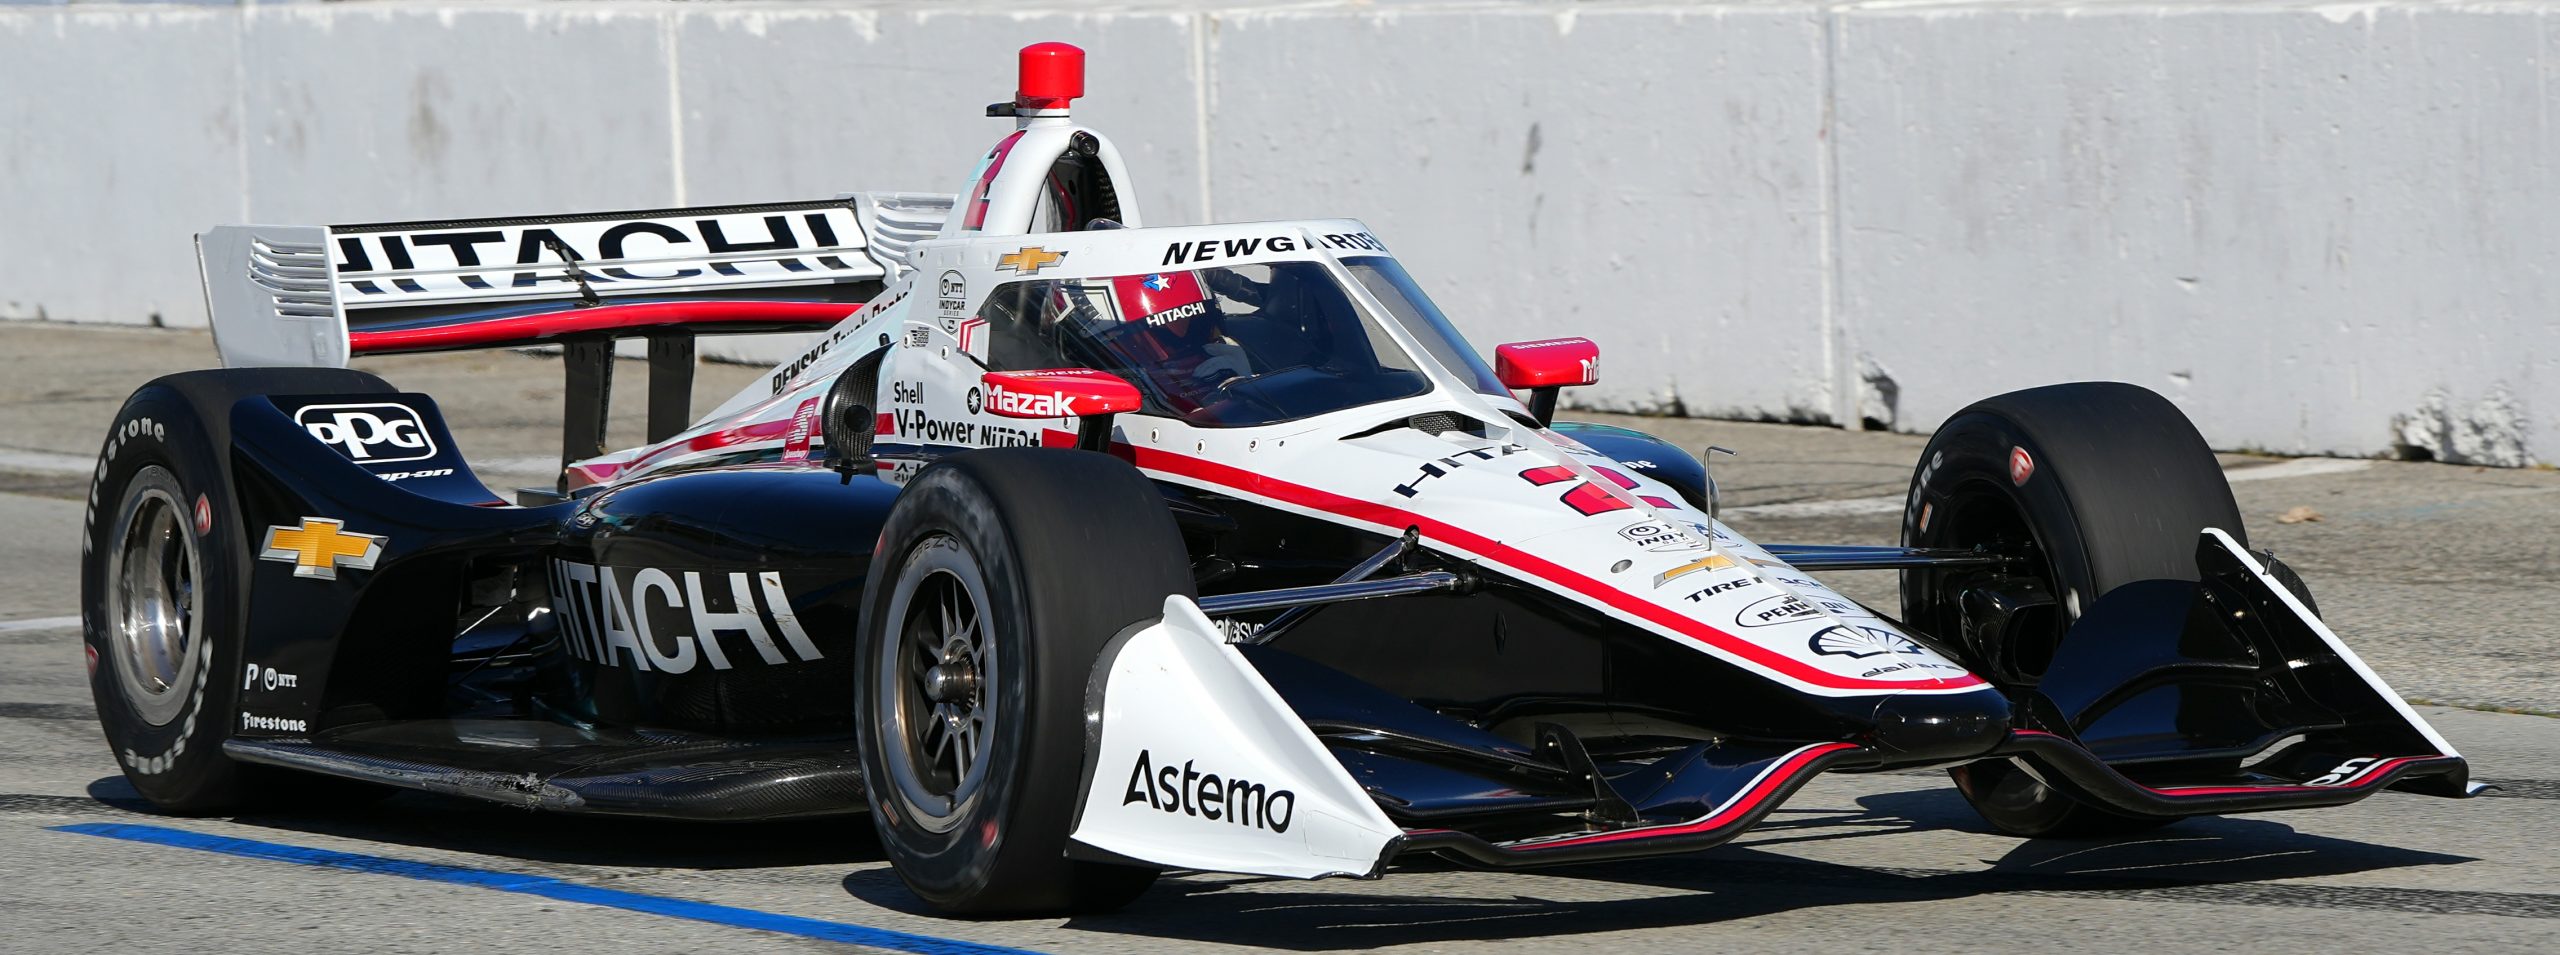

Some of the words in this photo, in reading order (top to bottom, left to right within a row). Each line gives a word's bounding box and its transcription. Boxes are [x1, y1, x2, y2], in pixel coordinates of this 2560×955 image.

[1162, 231, 1385, 266] NEWGRDE
[939, 300, 965, 310] INDYCAR
[1146, 302, 1206, 328] HITACHI
[894, 381, 924, 404] Shell
[983, 383, 1077, 416] Mazak
[306, 412, 425, 458] PPG
[895, 408, 975, 444] V-Power
[375, 468, 454, 482] ap-on
[1684, 578, 1752, 603] TIRE
[553, 556, 825, 675] HITACHI
[1757, 600, 1855, 622] PENNOIL
[278, 674, 297, 688] NTT
[242, 711, 307, 732] Firestone
[1123, 749, 1295, 834] Astemo
